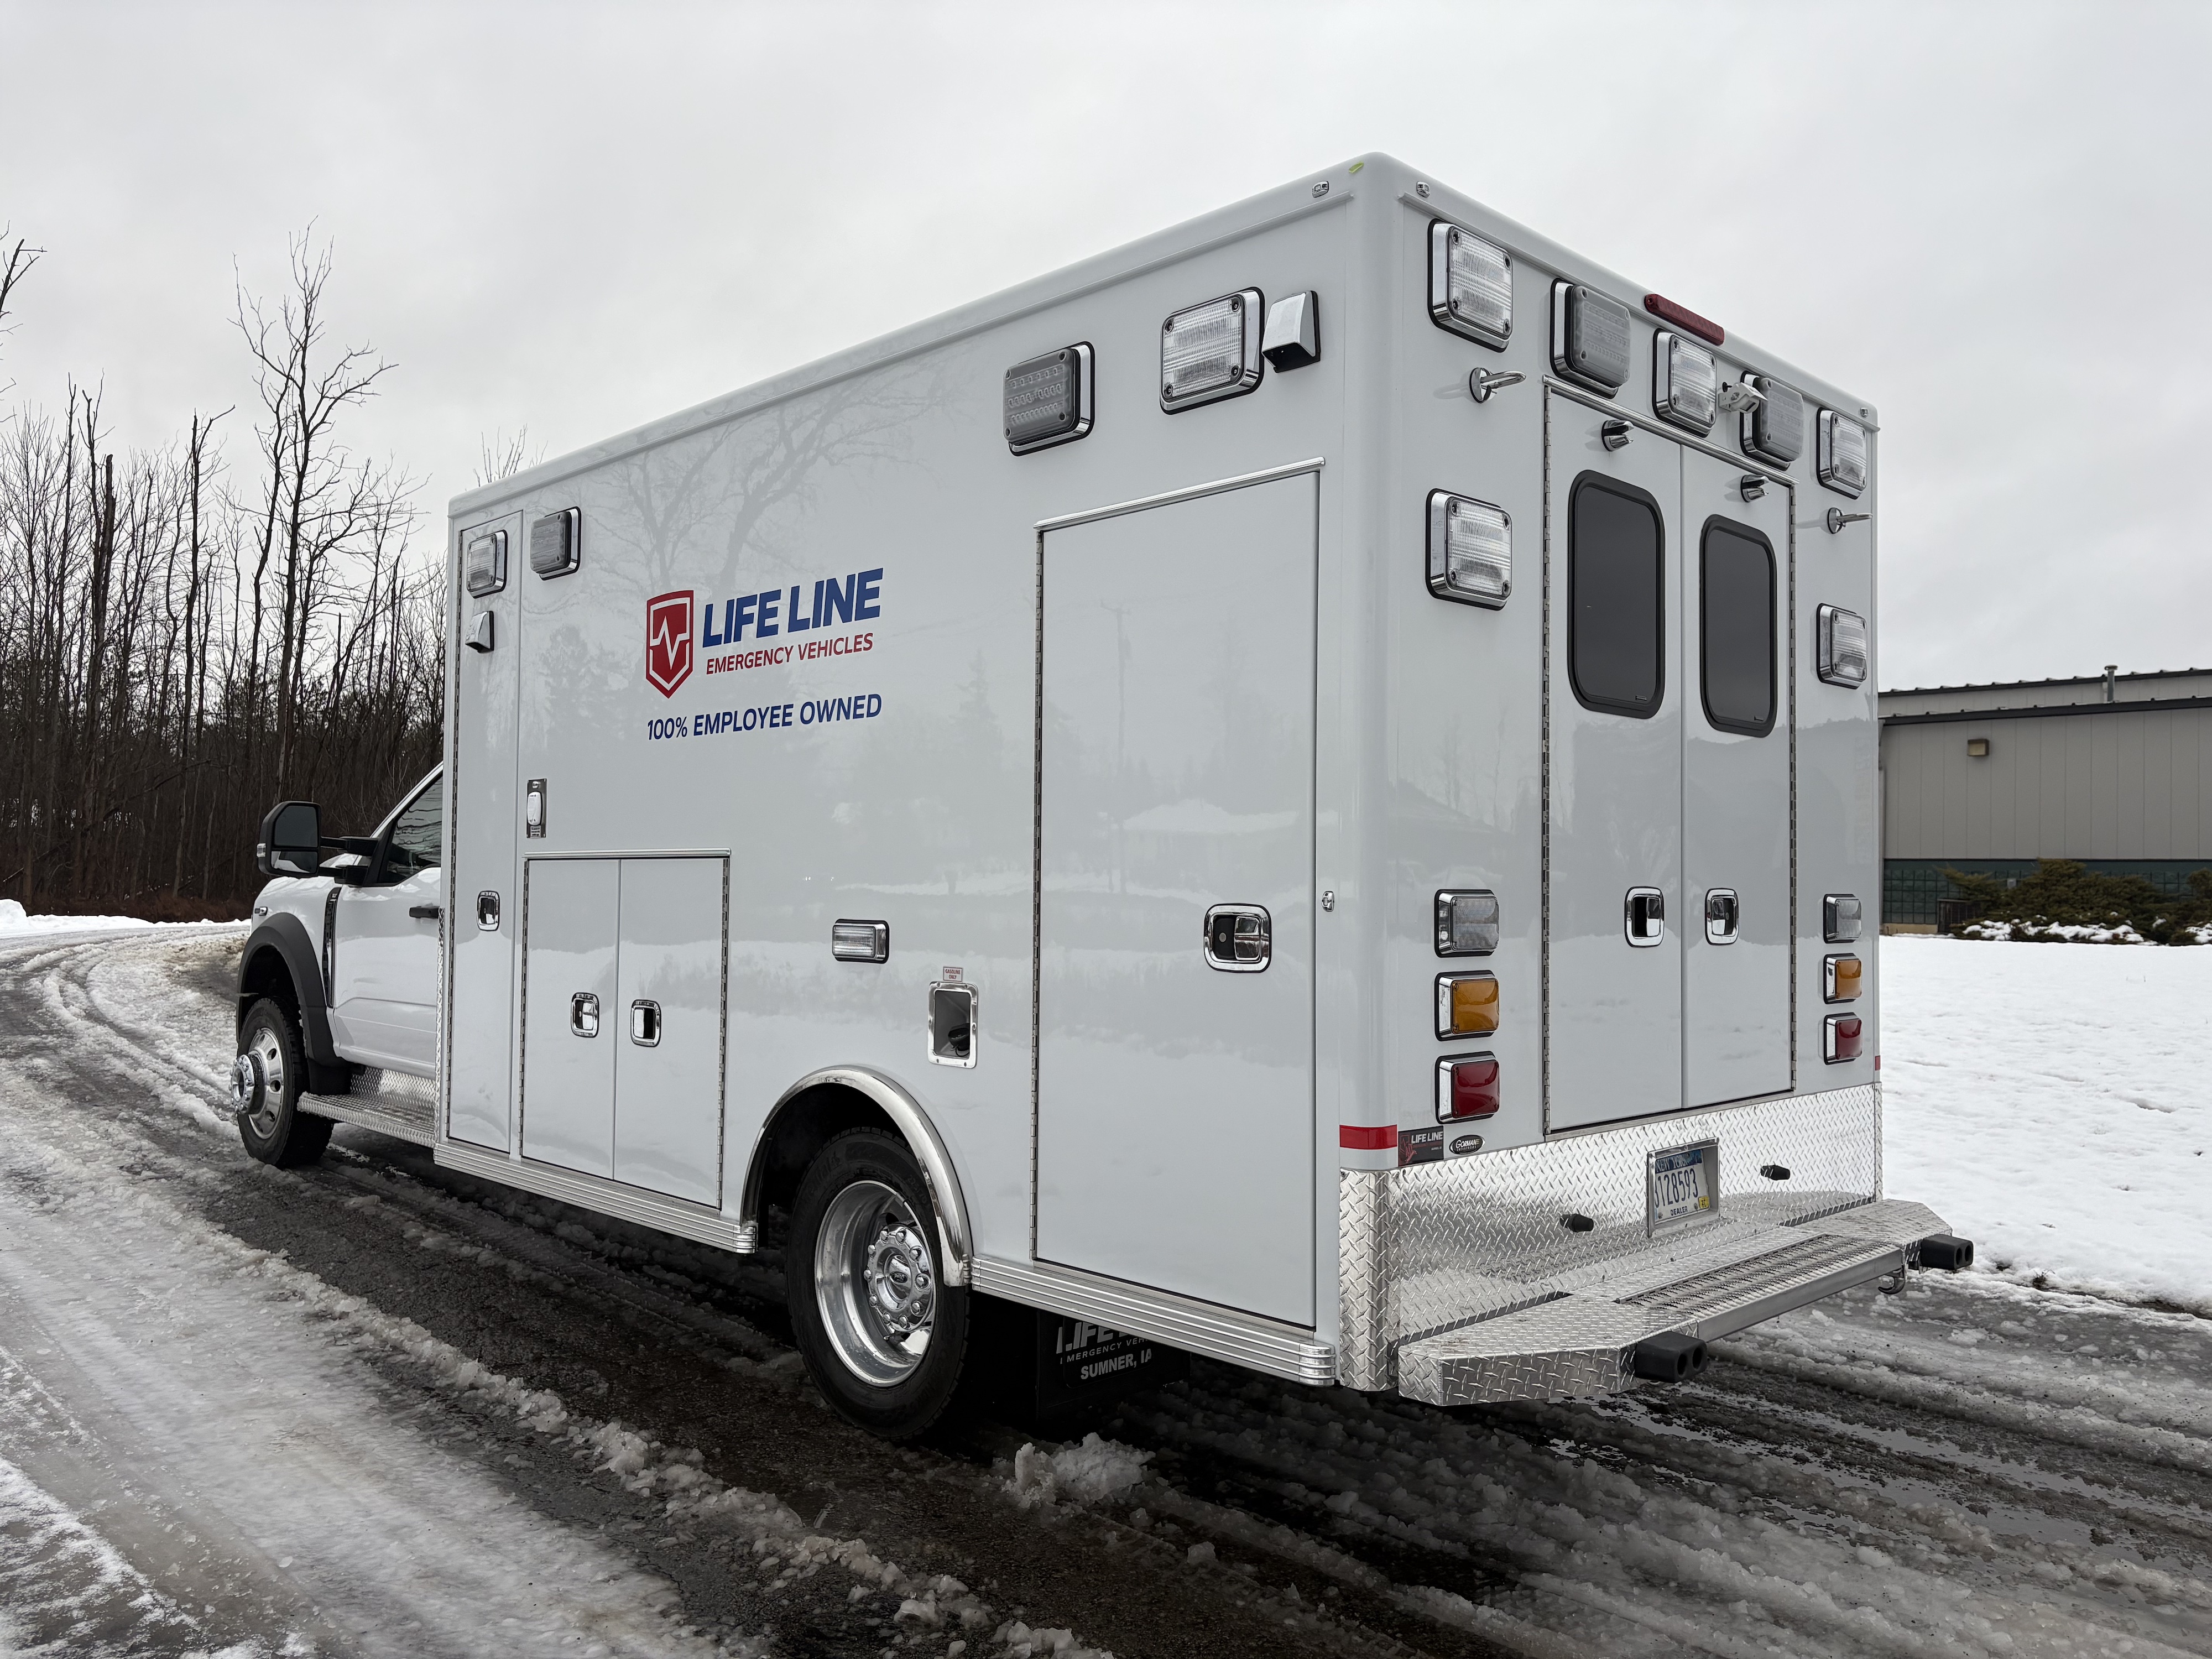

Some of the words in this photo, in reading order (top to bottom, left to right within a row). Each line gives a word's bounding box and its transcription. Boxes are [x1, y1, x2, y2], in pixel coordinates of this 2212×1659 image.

[702, 589, 781, 648] LIFE
[787, 568, 883, 633] LINE
[706, 645, 794, 675] EMERGENCY
[798, 633, 873, 661] VEHICLES
[648, 717, 687, 740] 100%
[693, 703, 794, 736] EMPLOYEE
[800, 693, 882, 725] OWNED
[1411, 1133, 1427, 1144] LIFE
[1427, 1131, 1443, 1141] LINE
[1656, 1158, 1670, 1172] NEW
[1671, 1154, 1687, 1169] YORK
[1670, 1206, 1688, 1216] DEALER
[1080, 1353, 1137, 1380] SUMNER,
[1140, 1348, 1152, 1364] IA
